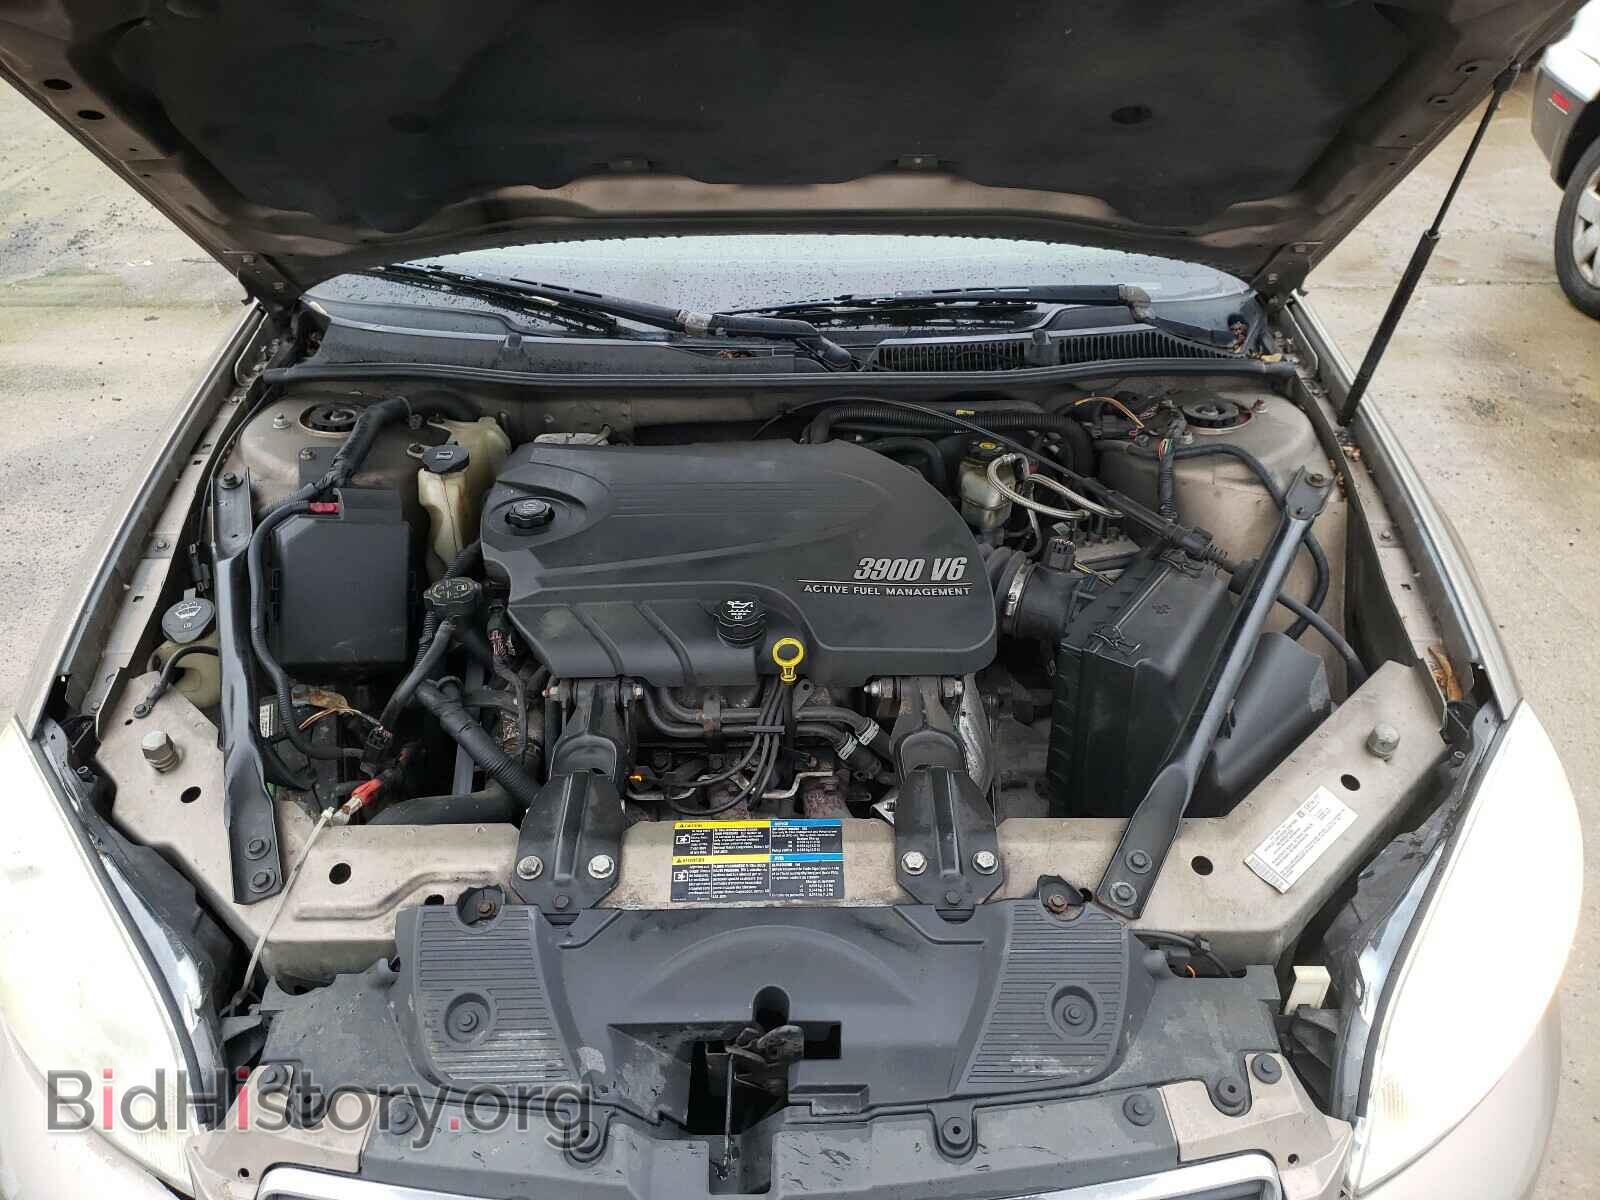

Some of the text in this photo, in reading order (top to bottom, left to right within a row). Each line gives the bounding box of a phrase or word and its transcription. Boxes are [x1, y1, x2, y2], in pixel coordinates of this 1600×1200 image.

[853, 556, 968, 581] 3900 V6
[803, 584, 972, 596] ACTIVE FUEL MANAGEMENT
